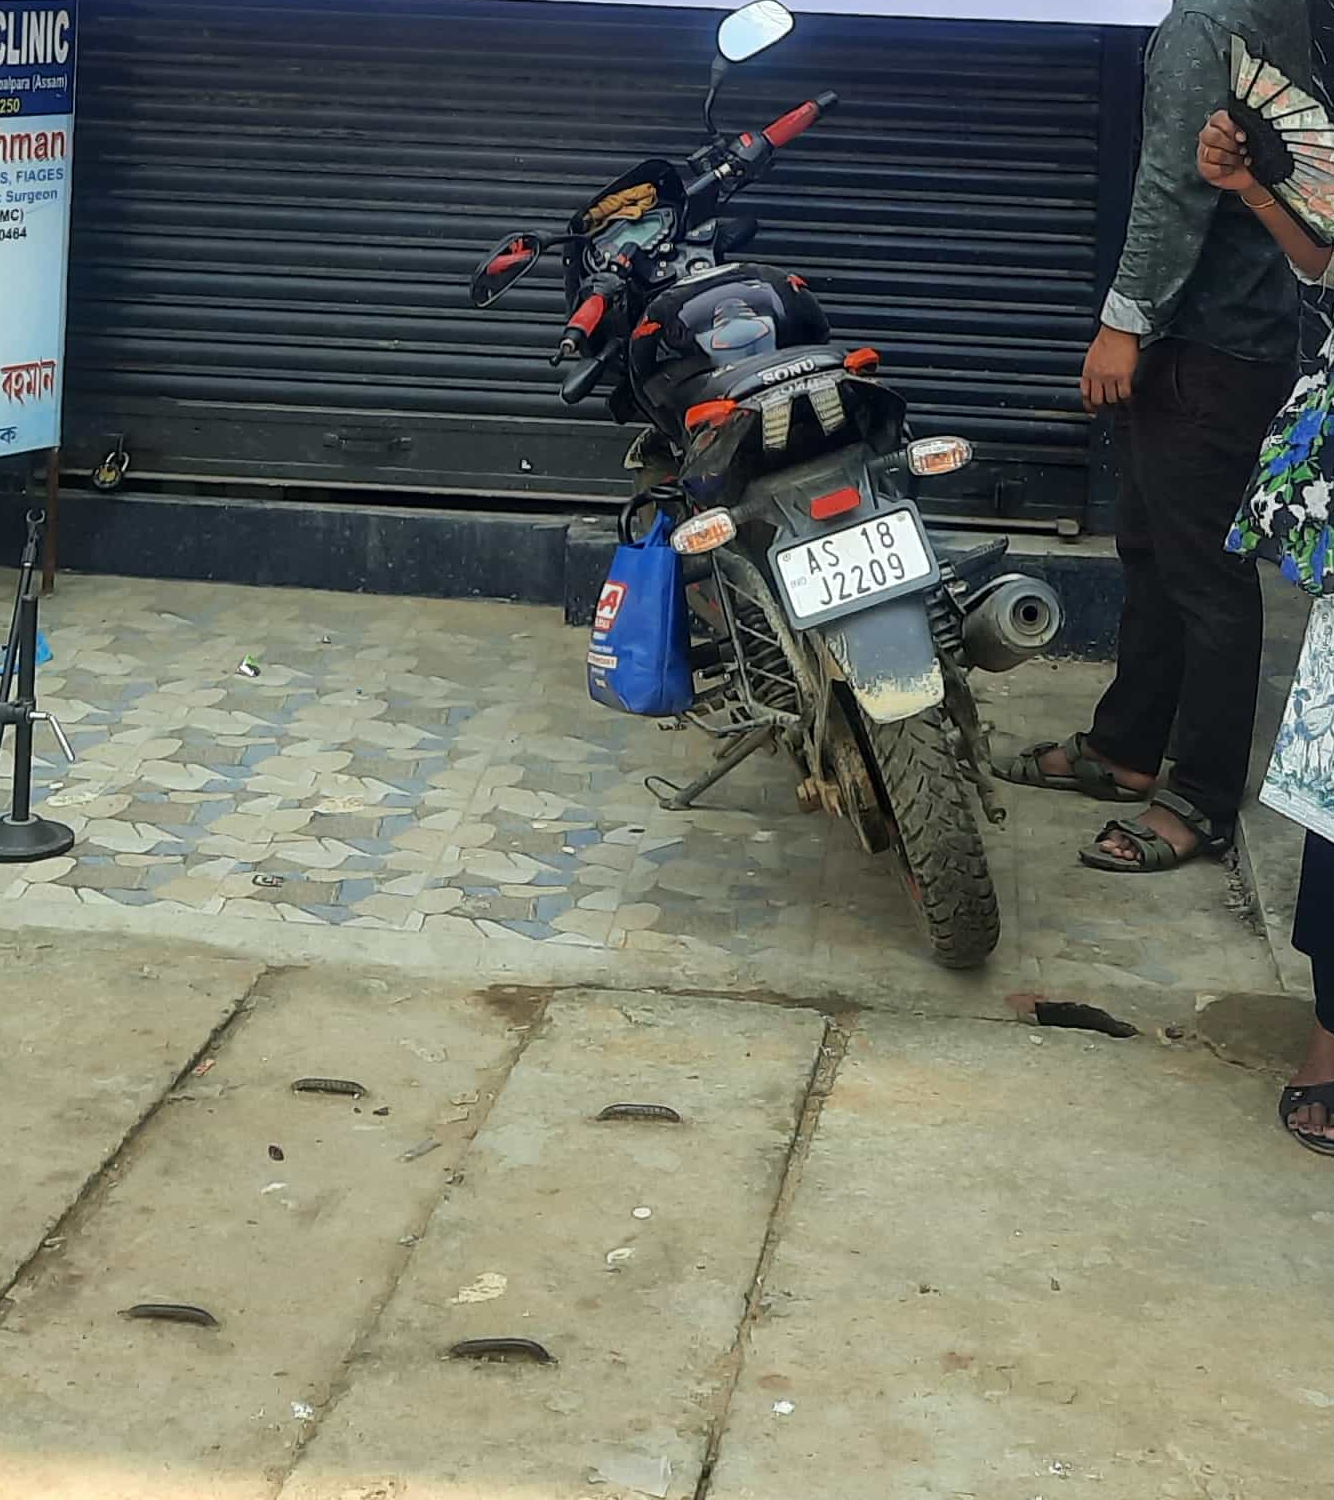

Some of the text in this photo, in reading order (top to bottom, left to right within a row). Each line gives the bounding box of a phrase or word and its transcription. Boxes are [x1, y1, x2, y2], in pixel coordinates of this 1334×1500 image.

[32, 72, 68, 90] (Assam)
[17, 167, 65, 183] FIAGES
[5, 188, 58, 205] Surgeon
[762, 357, 816, 386] SONU
[805, 521, 895, 576] AS 18
[819, 552, 906, 606] J2209
